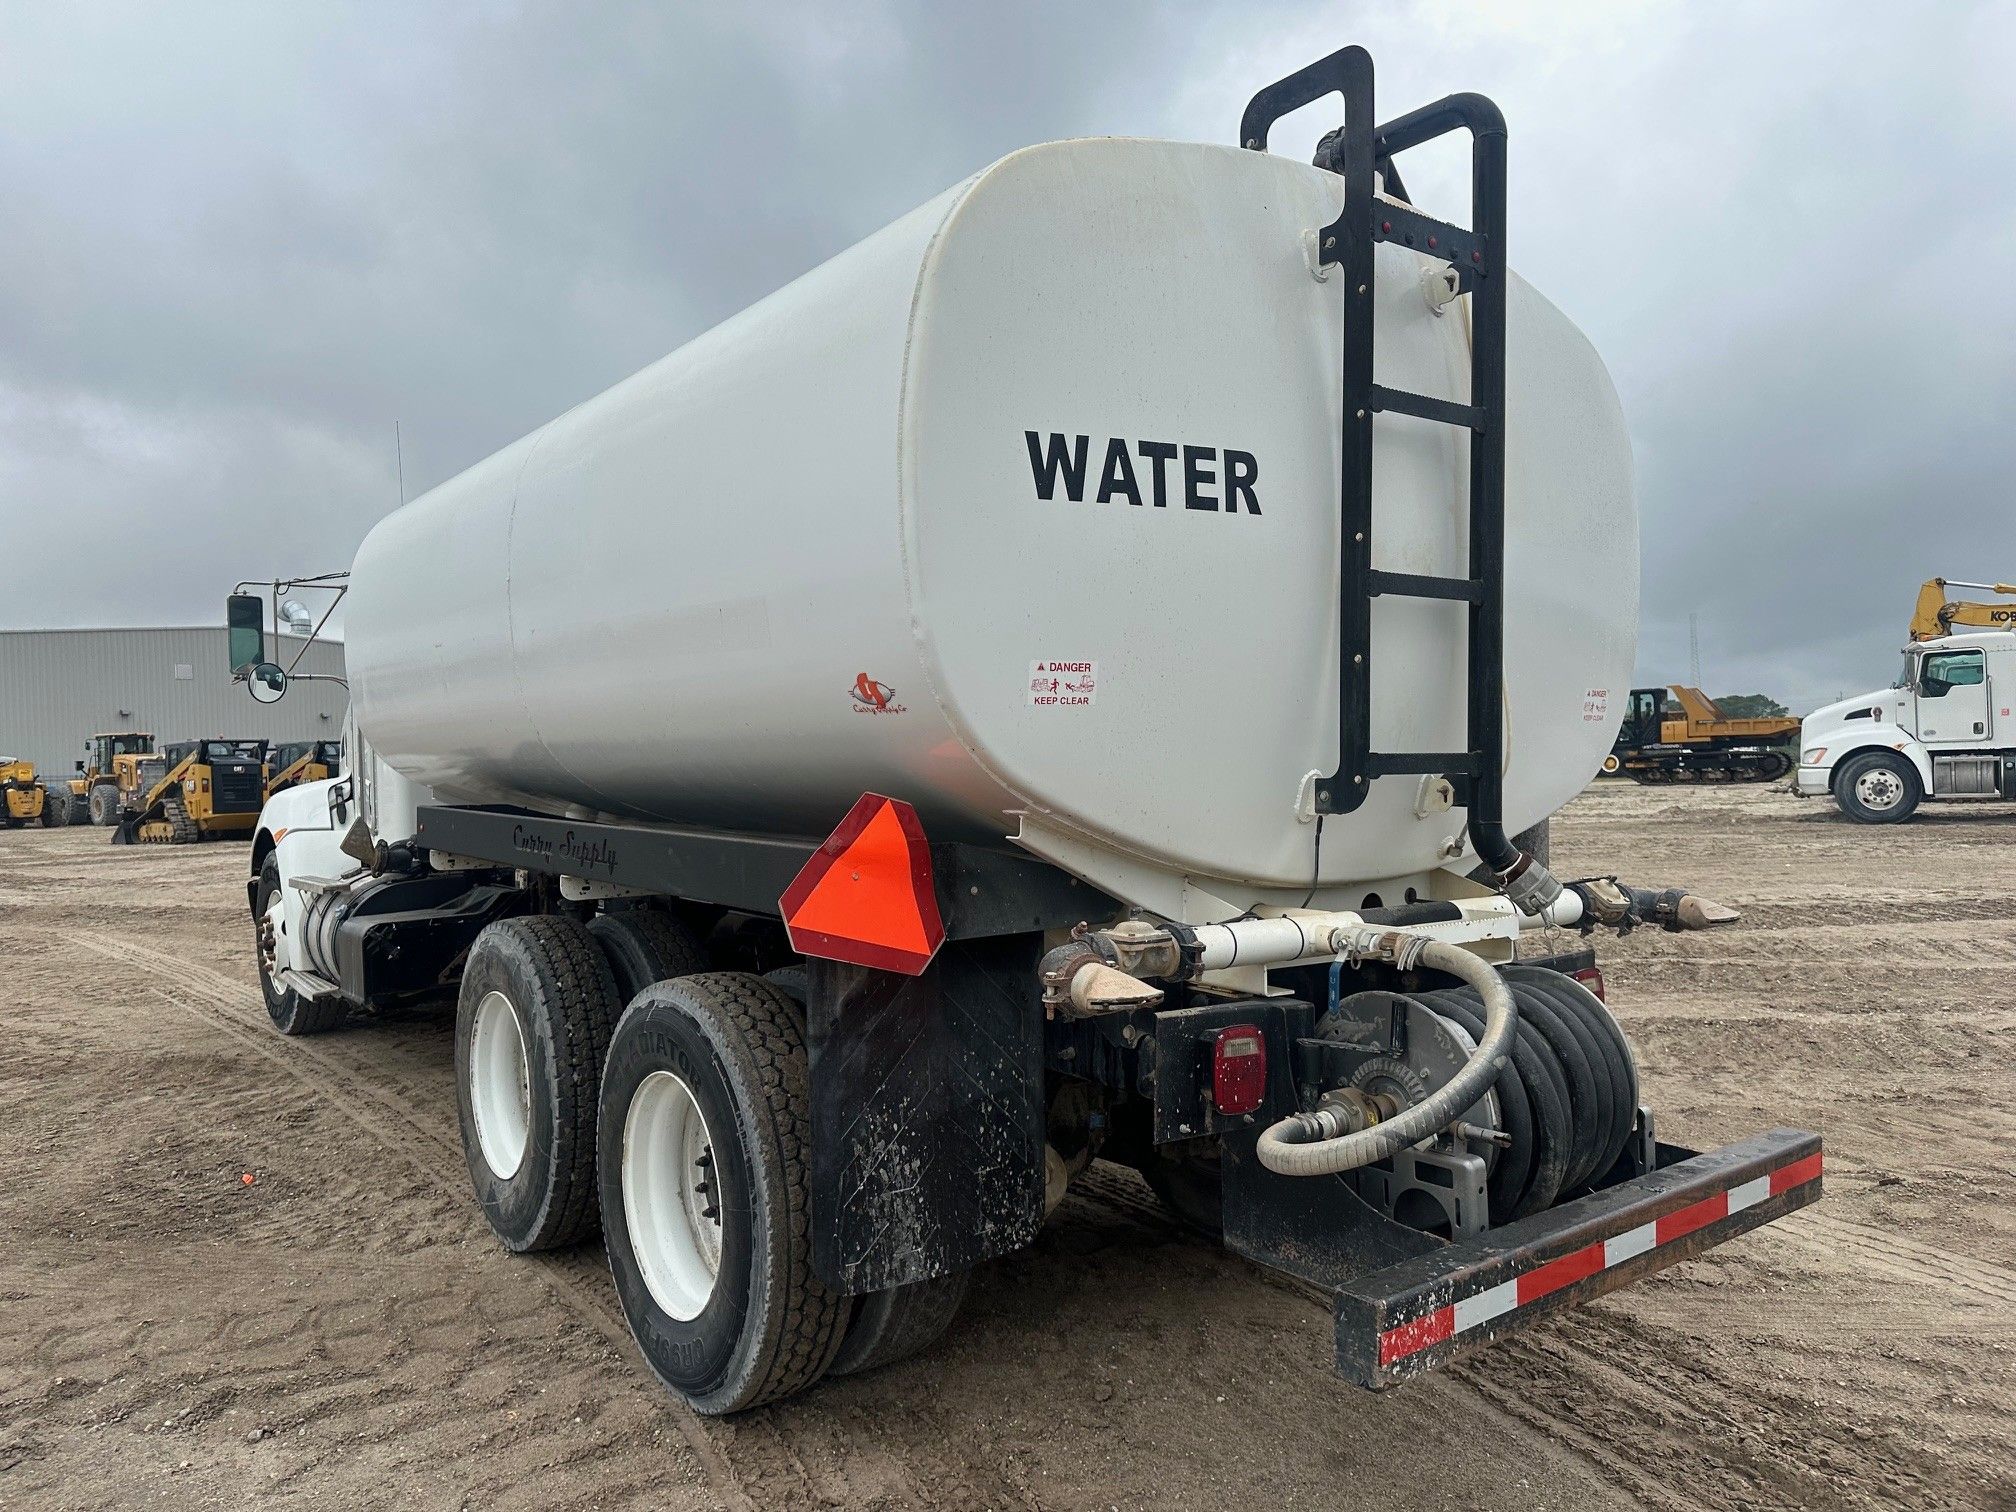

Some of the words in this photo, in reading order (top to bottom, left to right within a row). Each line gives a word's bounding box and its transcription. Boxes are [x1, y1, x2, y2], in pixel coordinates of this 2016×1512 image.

[1024, 430, 1263, 516] WATER
[1049, 662, 1091, 672] DANGER
[1034, 696, 1058, 704] KEEP
[1060, 696, 1089, 705] CLEAR
[513, 824, 552, 865] Curry
[560, 830, 619, 876] Supply
